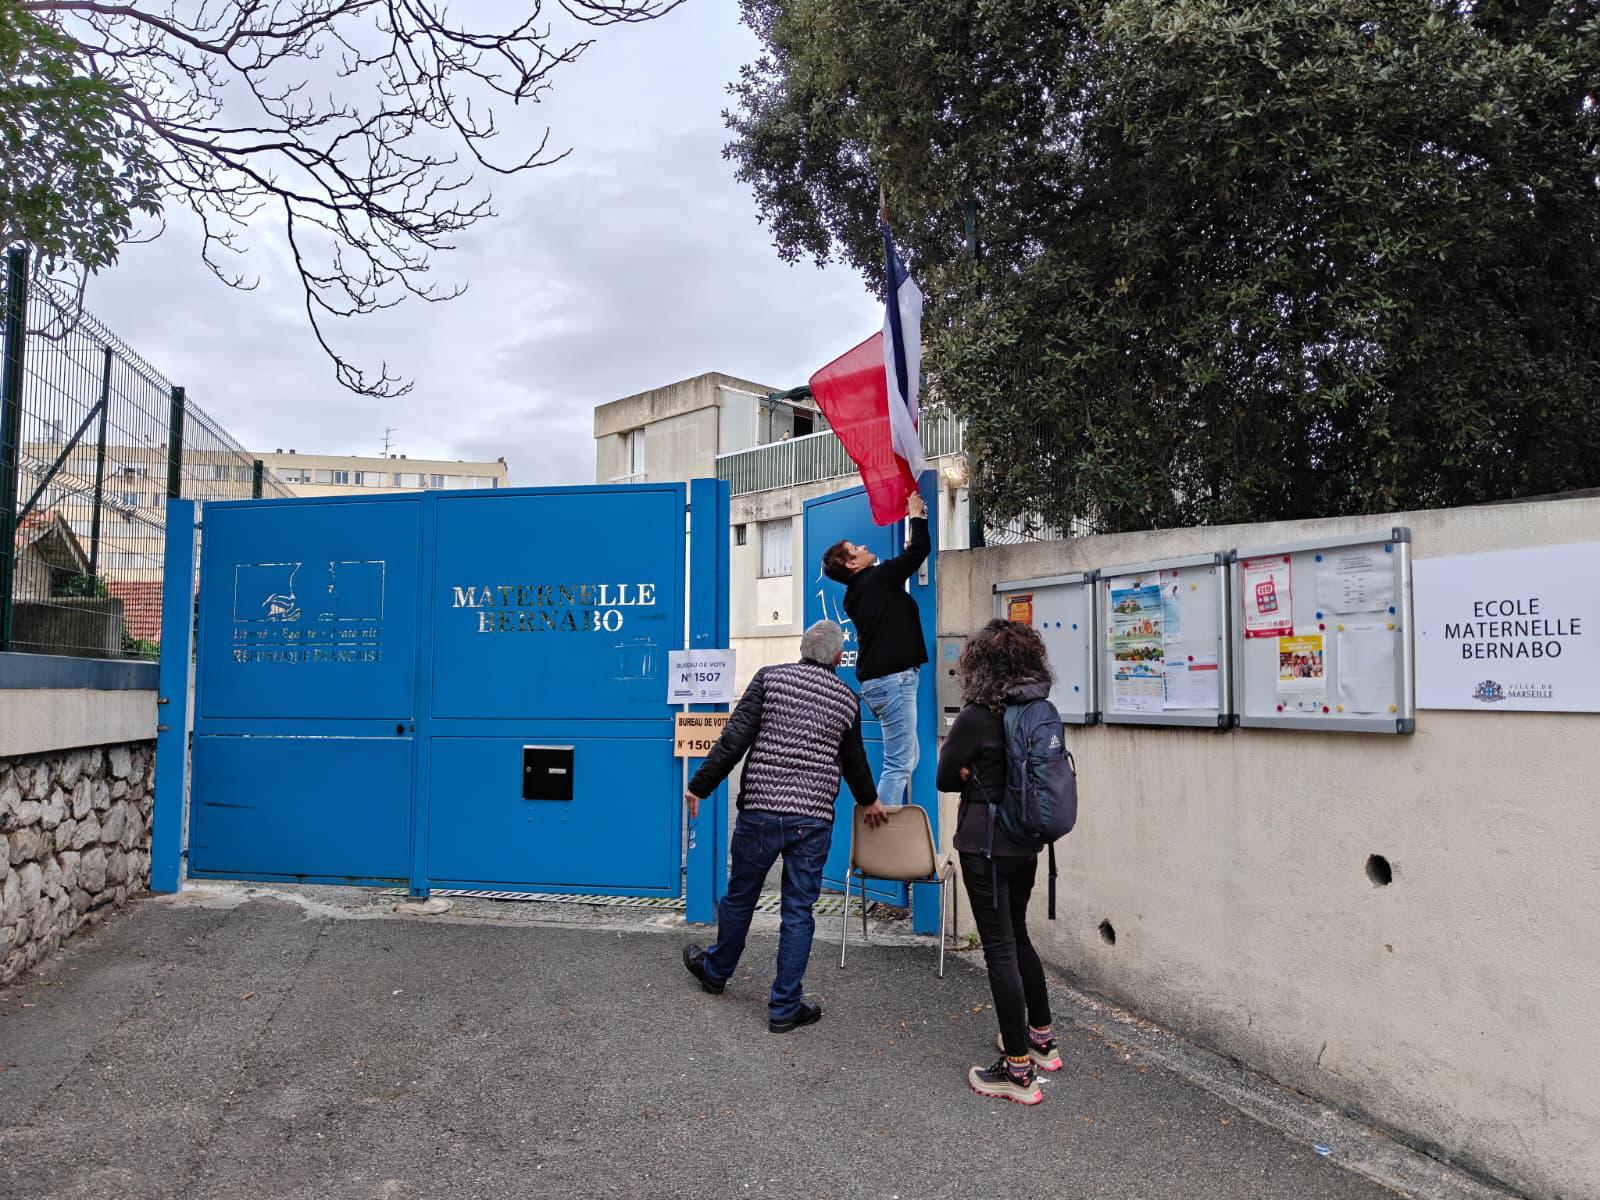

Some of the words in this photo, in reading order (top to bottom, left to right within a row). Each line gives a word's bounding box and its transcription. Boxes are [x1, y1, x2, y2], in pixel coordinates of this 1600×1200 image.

[452, 583, 656, 608] MATERNELLE
[1474, 598, 1540, 617] ECOLE
[477, 609, 624, 633] BERNABO
[1445, 618, 1581, 639] MATERNELLE
[1462, 640, 1562, 659] BERNABO
[681, 673, 691, 683] N°
[695, 672, 721, 682] 1507
[1508, 691, 1553, 699] MARSEILLE
[678, 717, 703, 727] BUREAU
[704, 717, 712, 727] DE
